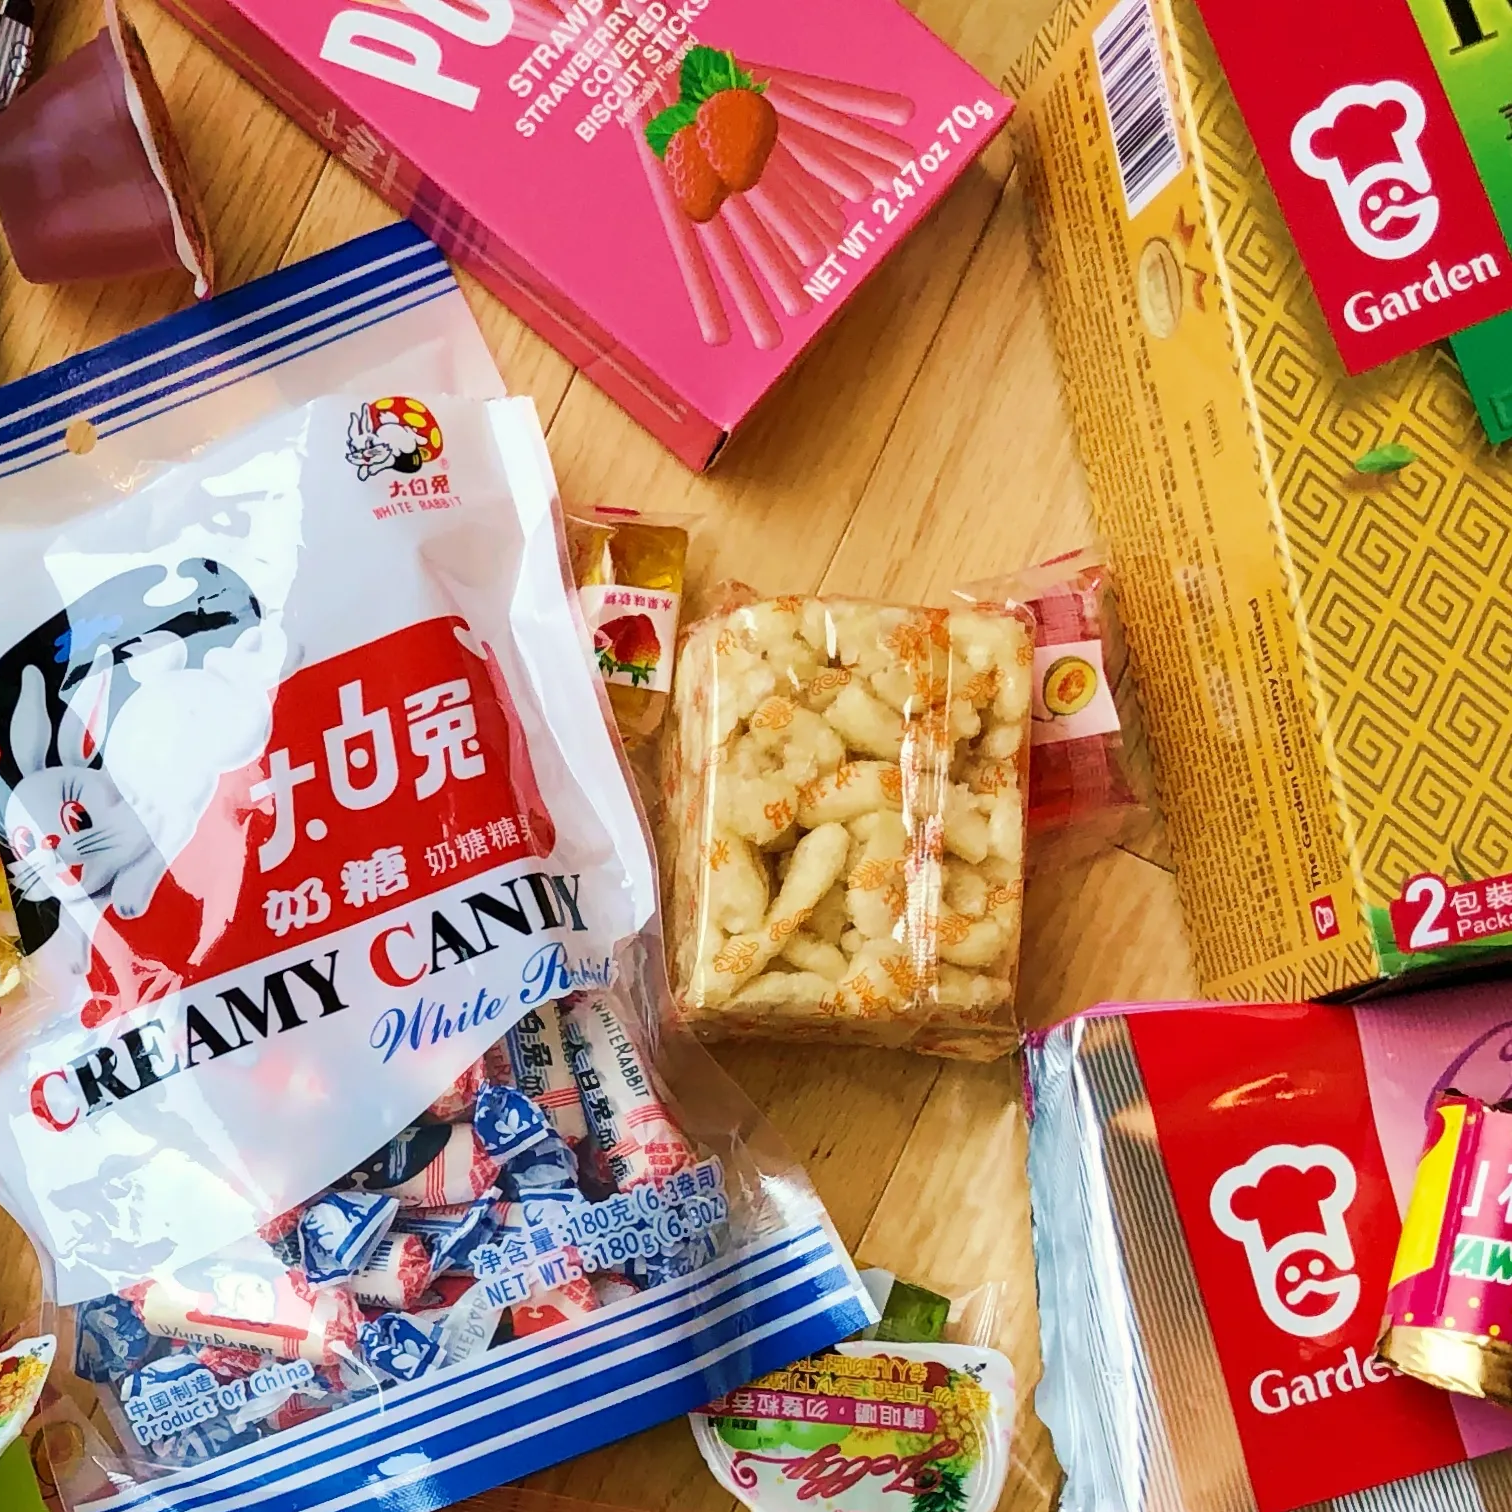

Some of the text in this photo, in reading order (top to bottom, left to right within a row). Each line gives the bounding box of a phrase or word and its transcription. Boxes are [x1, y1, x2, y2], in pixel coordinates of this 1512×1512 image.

[516, 2, 634, 137] STRAWBERRY
[582, 2, 666, 97] COVERED
[574, 60, 646, 143] BISCUIT
[615, 78, 662, 129] Artificially
[803, 100, 994, 303] NET WT. 2.47oz 70g
[1343, 253, 1501, 333] Garden
[372, 496, 463, 520] WHITE RABBIT
[389, 474, 450, 498] 大白兔
[250, 678, 486, 873] 大白兔
[1248, 597, 1324, 891] The Garden Company Limited
[263, 845, 409, 938] 奶糖
[1405, 877, 1449, 949] 2
[28, 873, 588, 1132] CREAMY CANDY
[369, 985, 507, 1066] White
[485, 1273, 528, 1307] NET
[130, 1372, 216, 1419] 中国制造
[139, 1364, 310, 1442] Product Of China
[1250, 1347, 1402, 1414] Garde
